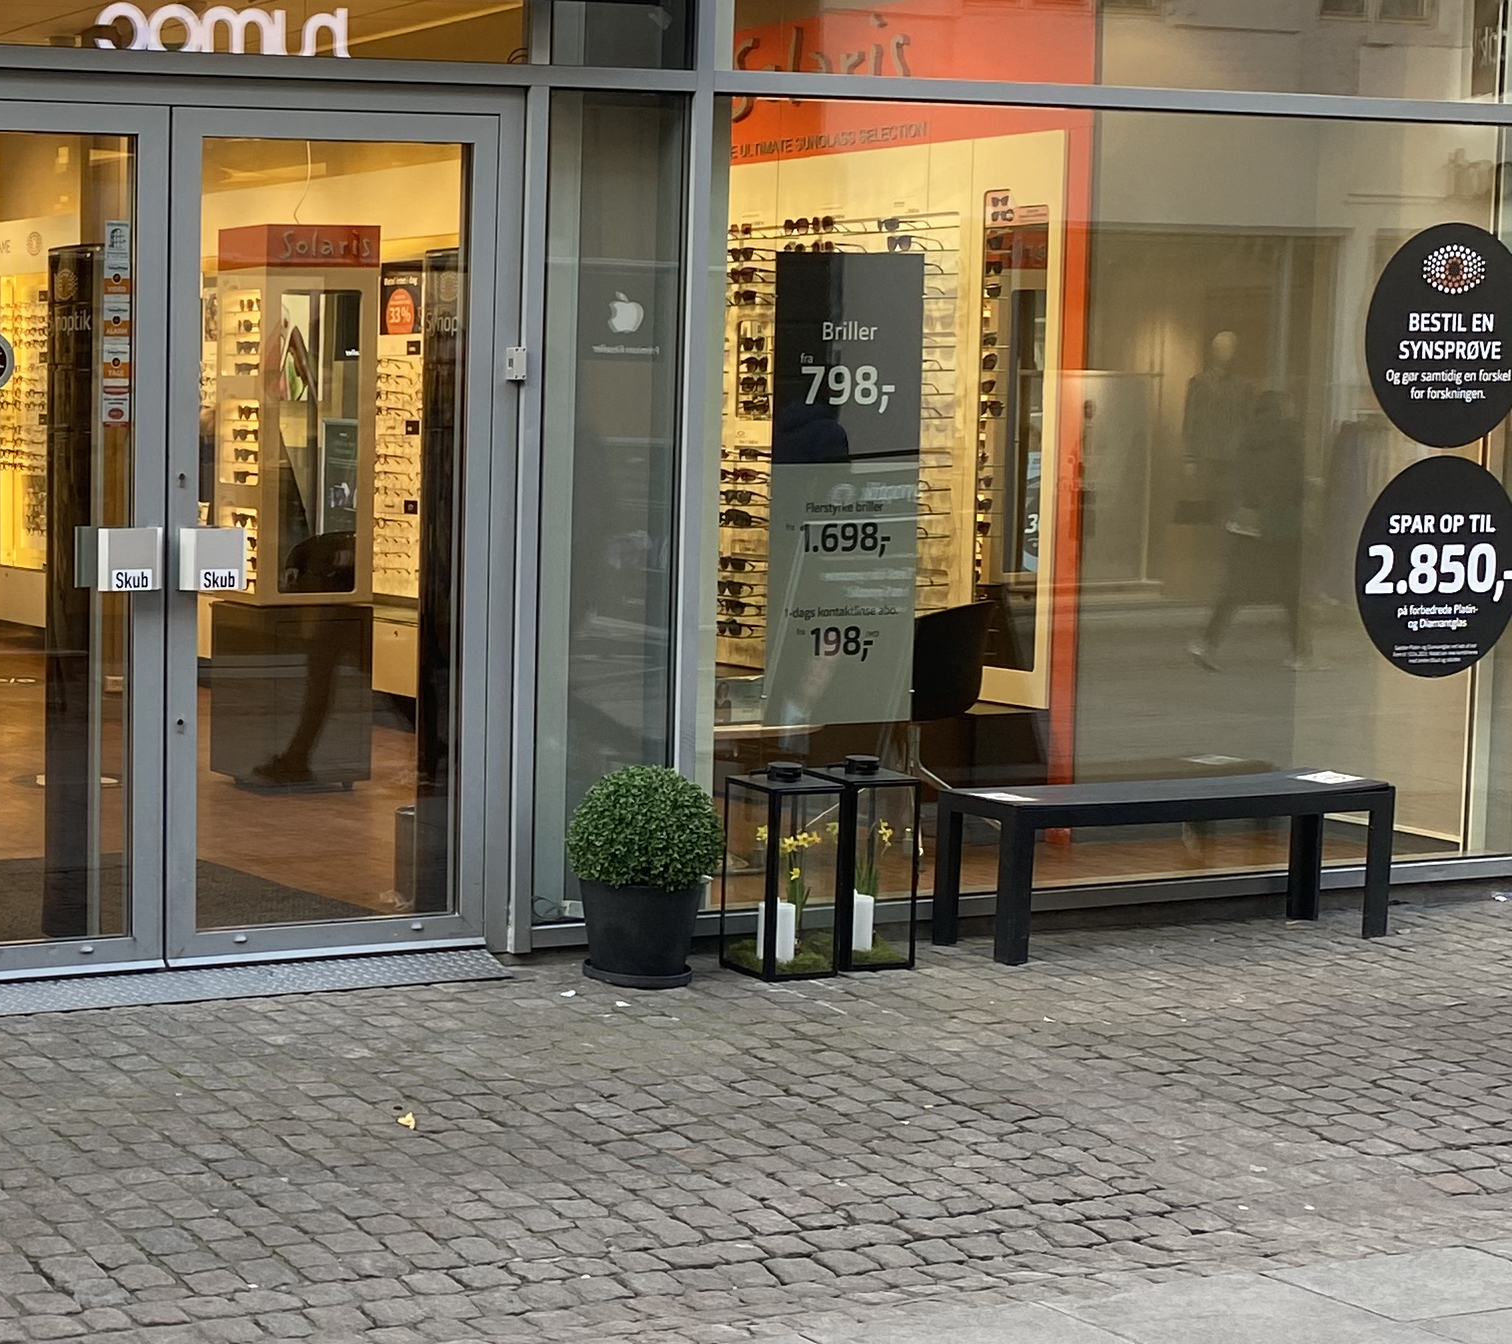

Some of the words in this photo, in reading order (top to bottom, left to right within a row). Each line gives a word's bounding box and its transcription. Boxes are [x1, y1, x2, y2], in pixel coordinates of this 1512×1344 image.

[279, 229, 371, 259] Solaris
[822, 320, 878, 340] Briller
[1408, 312, 1467, 332] BESTIL
[1471, 313, 1495, 333] EN
[800, 353, 814, 364] fra
[1398, 340, 1502, 360] SYNSPRØVE
[1385, 369, 1401, 385] Og
[1420, 369, 1463, 385] samtidig
[1464, 372, 1477, 382] en
[1478, 369, 1512, 382] forskel
[800, 365, 896, 414] 798,-
[1388, 514, 1436, 534] SPAR
[1439, 514, 1465, 533] OP
[1469, 514, 1497, 533] TIL
[800, 522, 891, 558] 1.698,-
[115, 571, 149, 589] Skub
[203, 571, 236, 589] Skub
[1397, 605, 1408, 618] på
[1409, 604, 1453, 615] forbedrede
[1408, 620, 1419, 631] og
[810, 625, 874, 662] 198,-
